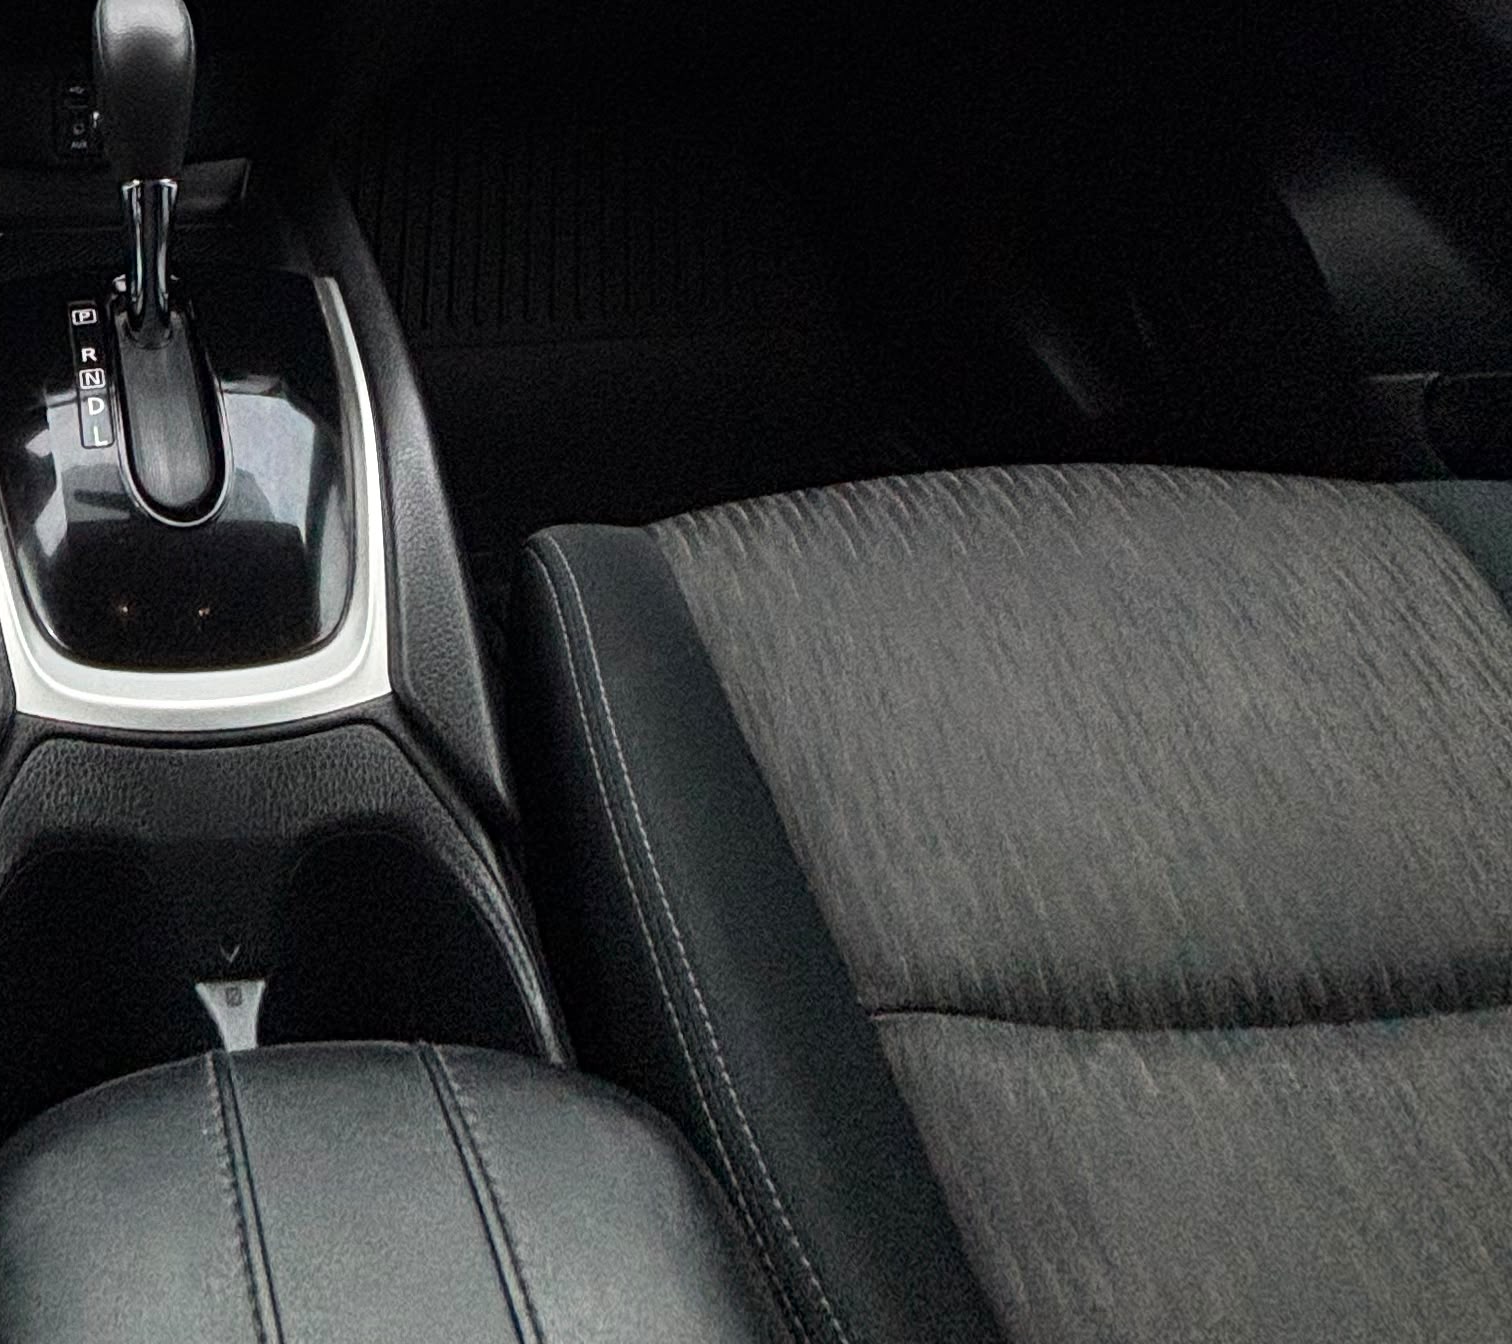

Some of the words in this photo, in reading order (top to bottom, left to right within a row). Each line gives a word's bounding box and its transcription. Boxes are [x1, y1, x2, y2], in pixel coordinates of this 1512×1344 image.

[80, 346, 98, 363] R
[84, 370, 101, 386] N
[87, 396, 105, 416] D
[93, 425, 109, 448] L
